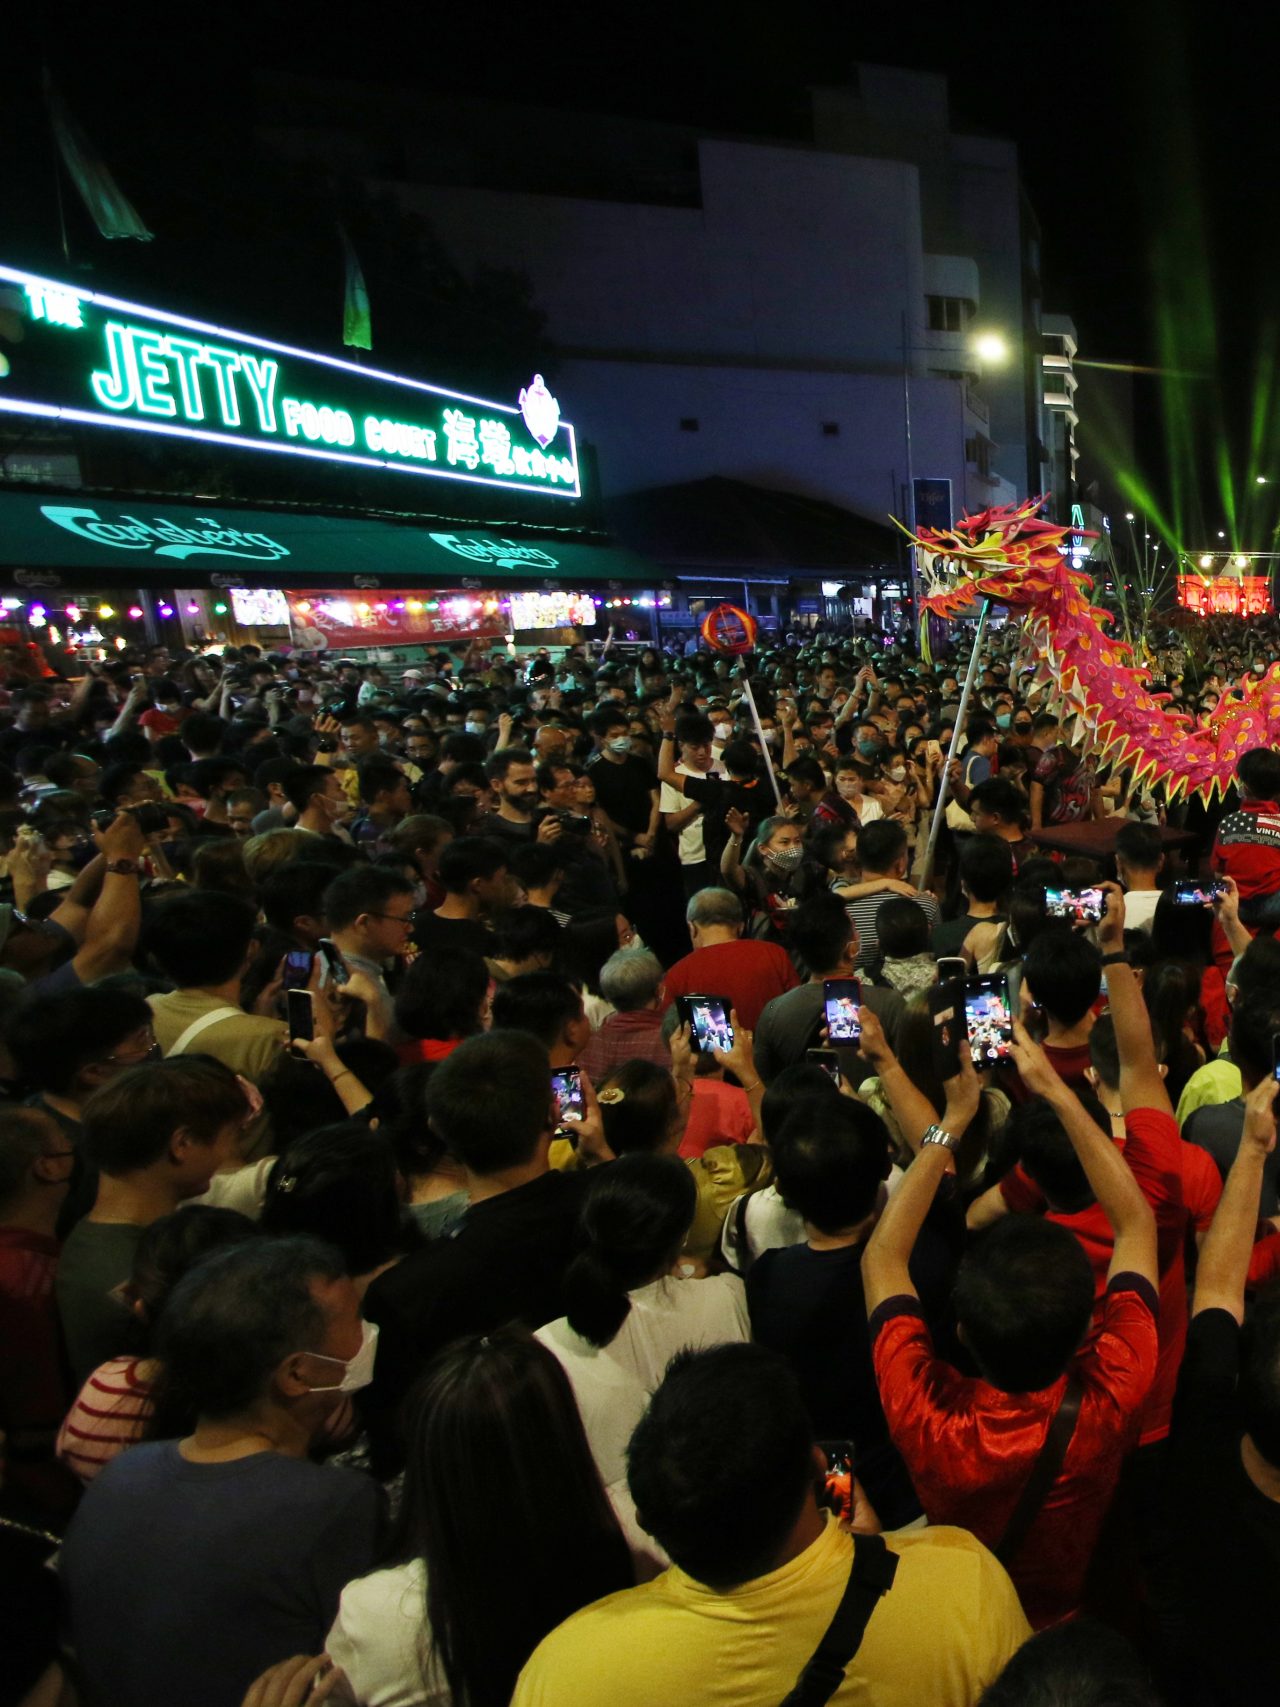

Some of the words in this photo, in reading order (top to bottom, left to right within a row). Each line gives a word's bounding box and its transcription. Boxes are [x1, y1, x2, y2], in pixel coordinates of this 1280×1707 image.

[25, 283, 84, 329] THE
[91, 321, 279, 433] JETTY
[282, 399, 355, 446] FOOD
[364, 417, 437, 461] COURT
[40, 505, 291, 560] Carlsberg
[429, 533, 560, 569] Carlsberg
